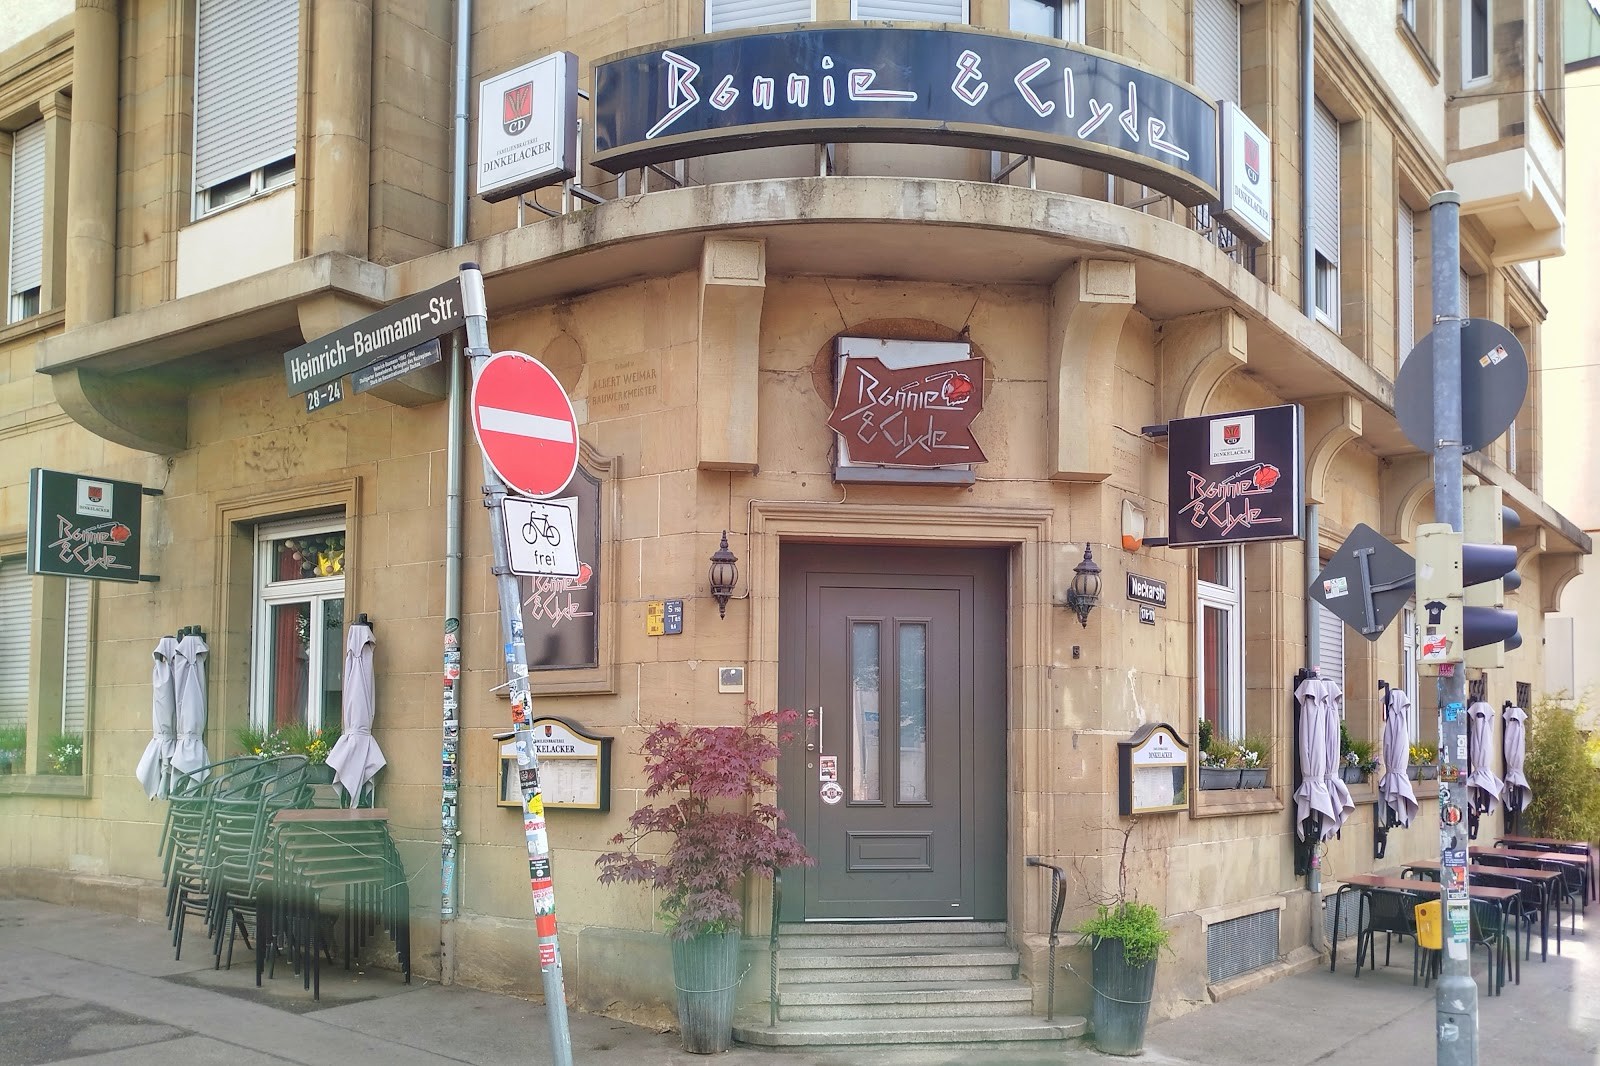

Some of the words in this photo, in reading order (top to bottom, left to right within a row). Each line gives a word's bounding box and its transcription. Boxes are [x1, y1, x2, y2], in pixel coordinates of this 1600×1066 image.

[645, 50, 917, 139] Bonnie
[950, 49, 988, 105] &
[1014, 58, 1189, 160] Clyde
[509, 119, 526, 133] CD
[483, 141, 551, 173] DINKELACKER
[1247, 168, 1257, 182] CD
[1234, 185, 1269, 221] DINKELACKER
[290, 296, 458, 385] Heinrich-Baumann-Str.
[592, 375, 621, 391] ALBERT
[623, 369, 657, 384] WEIMAR
[841, 365, 964, 421] Bonnie
[857, 411, 878, 444] &
[879, 410, 969, 459] Clyde
[1213, 449, 1251, 458] DINKELACKER
[1178, 470, 1272, 514] Bonnie
[48, 514, 125, 548] Bonnie
[1191, 501, 1208, 528] &
[1208, 498, 1282, 536] Clyde
[59, 540, 74, 563] &
[73, 540, 131, 572] Clyde
[534, 550, 556, 566] frei
[1131, 577, 1166, 602] Neckarstr.
[532, 595, 544, 620] &
[543, 591, 593, 628] Clyde
[536, 745, 575, 753] KELACKER
